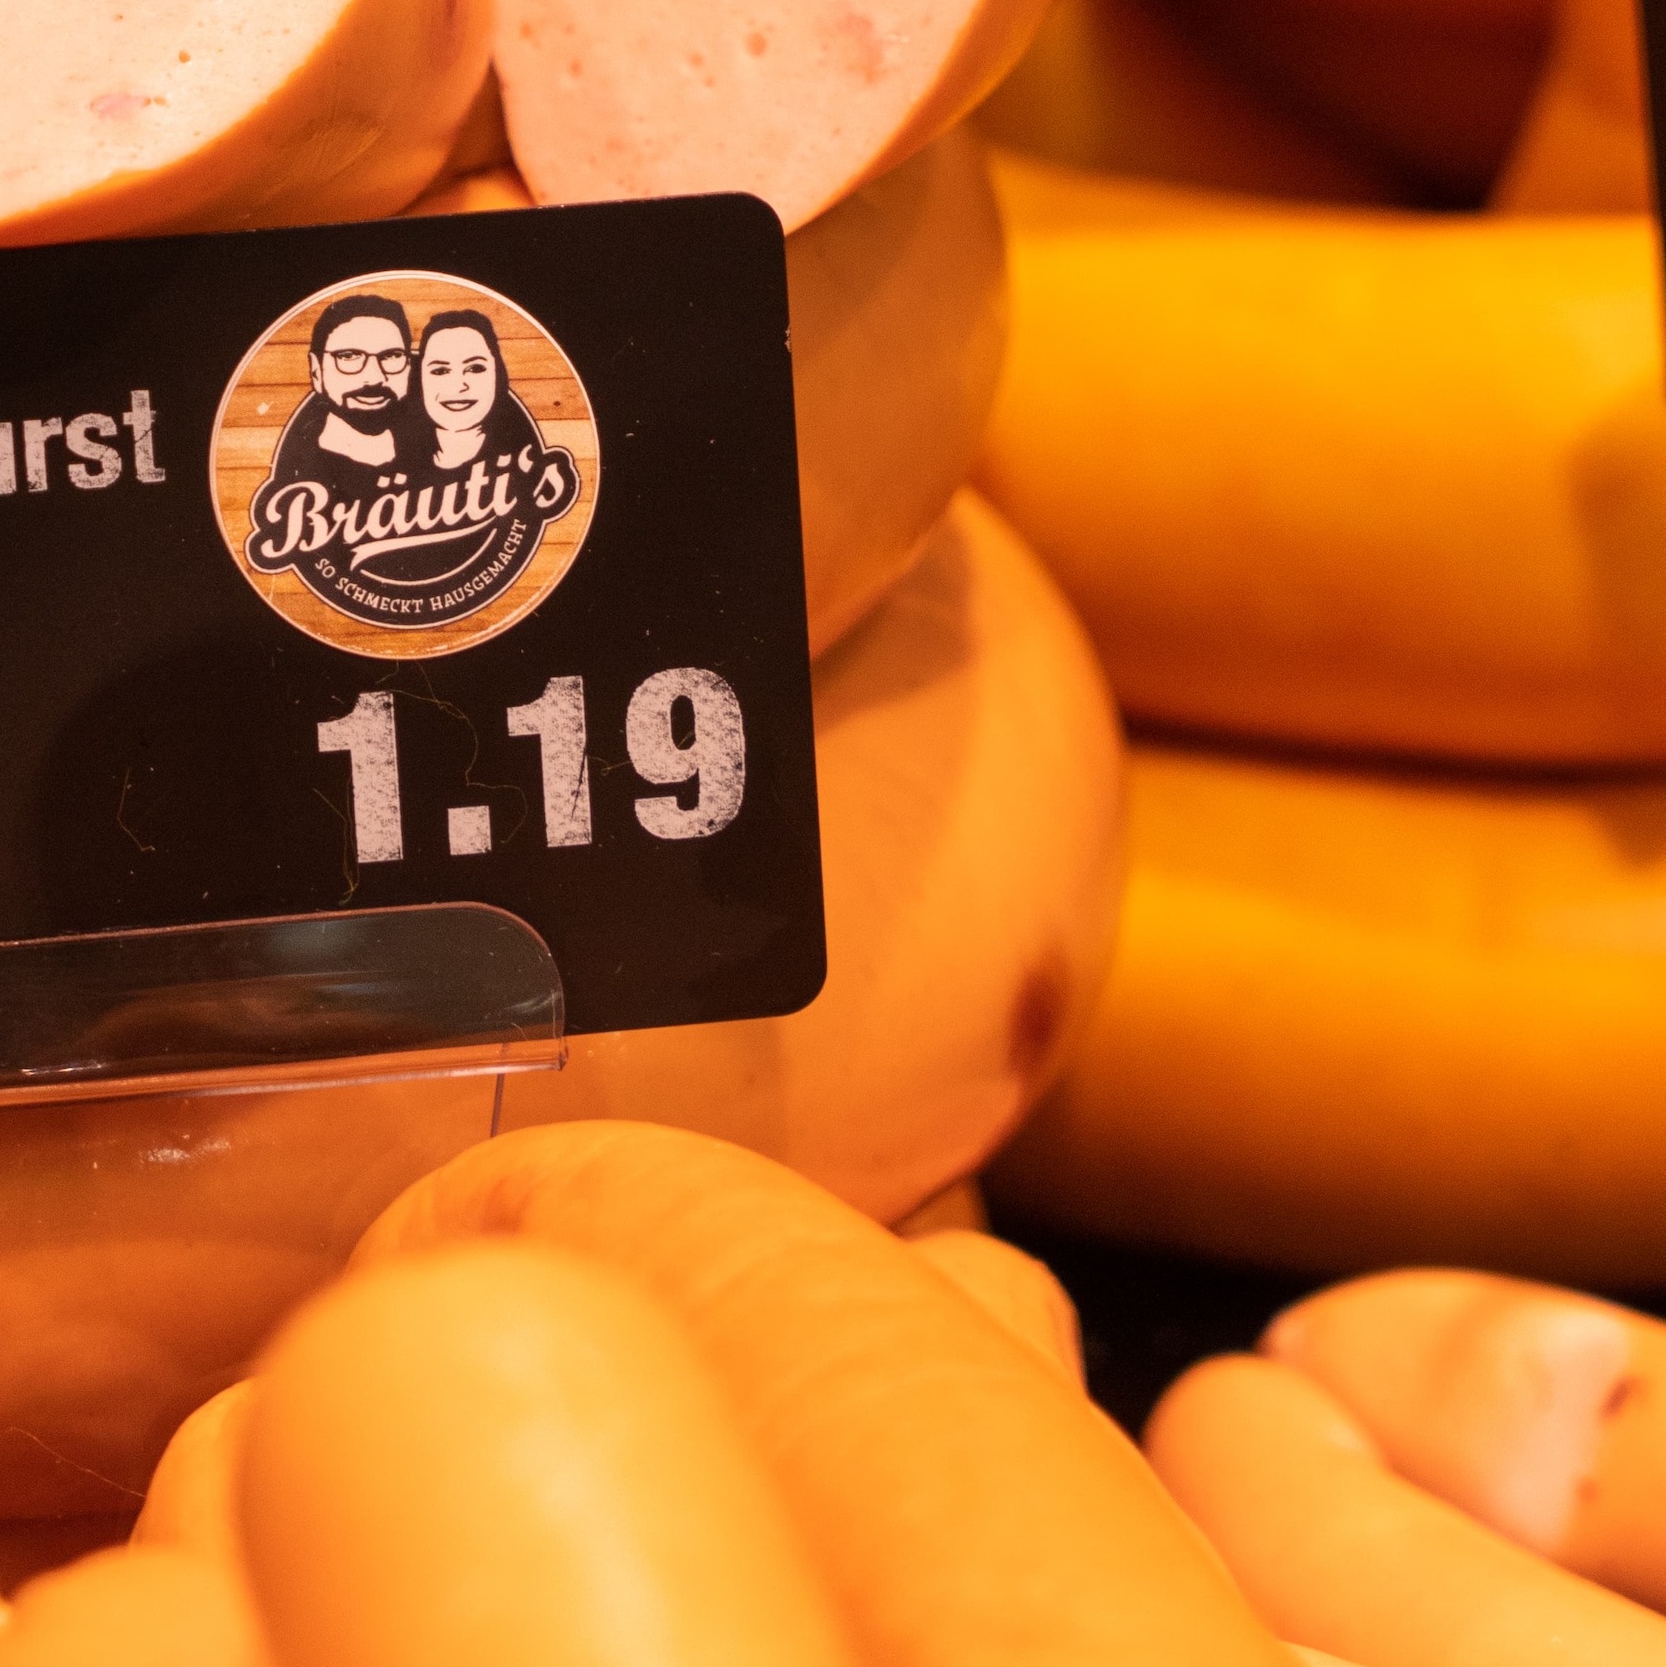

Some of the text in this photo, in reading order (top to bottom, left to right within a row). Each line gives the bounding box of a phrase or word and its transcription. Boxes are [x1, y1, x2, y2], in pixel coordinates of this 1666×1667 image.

[314, 518, 528, 614] SO SCHMECKT HAUSGEMACHT
[317, 667, 746, 863] 1.19
